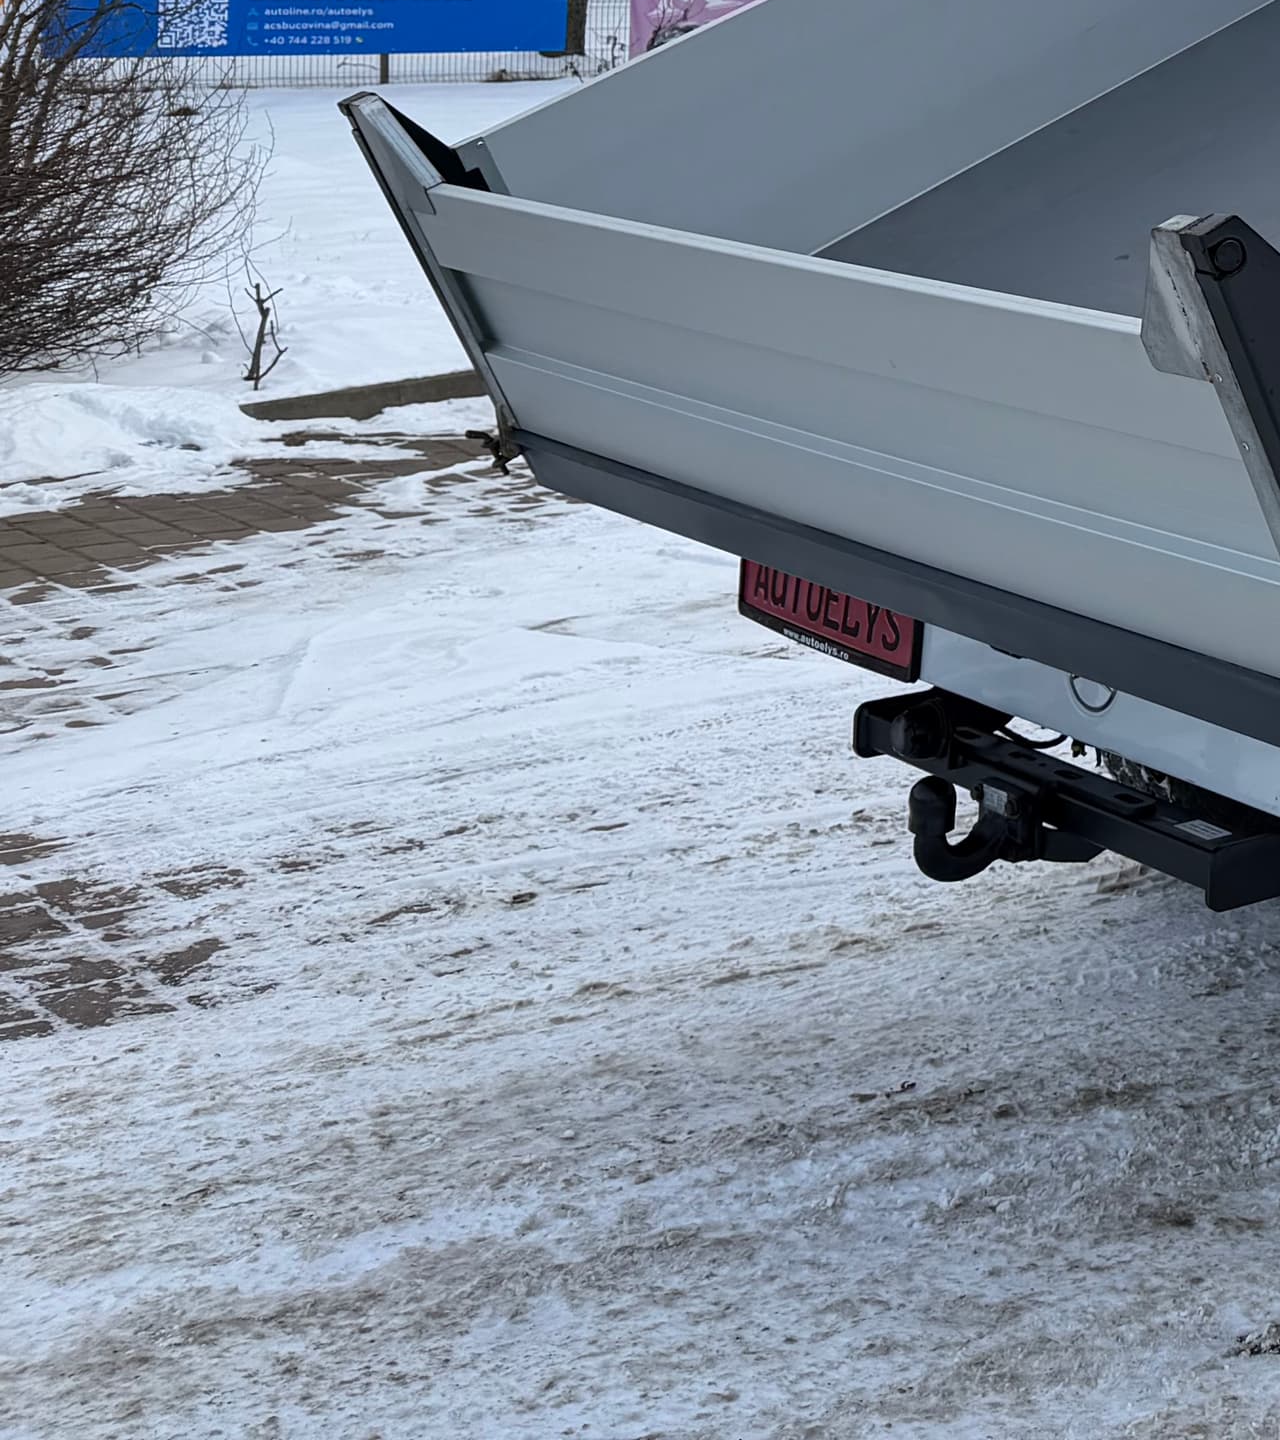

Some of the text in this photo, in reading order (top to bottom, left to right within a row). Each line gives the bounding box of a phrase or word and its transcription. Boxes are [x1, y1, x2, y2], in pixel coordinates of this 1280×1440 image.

[264, 7, 374, 17] autoline.ro/autoelys
[263, 21, 394, 31] acsbucovina@gmail.com
[288, 36, 308, 45] 744
[783, 628, 849, 660] www.autoelys.ro
